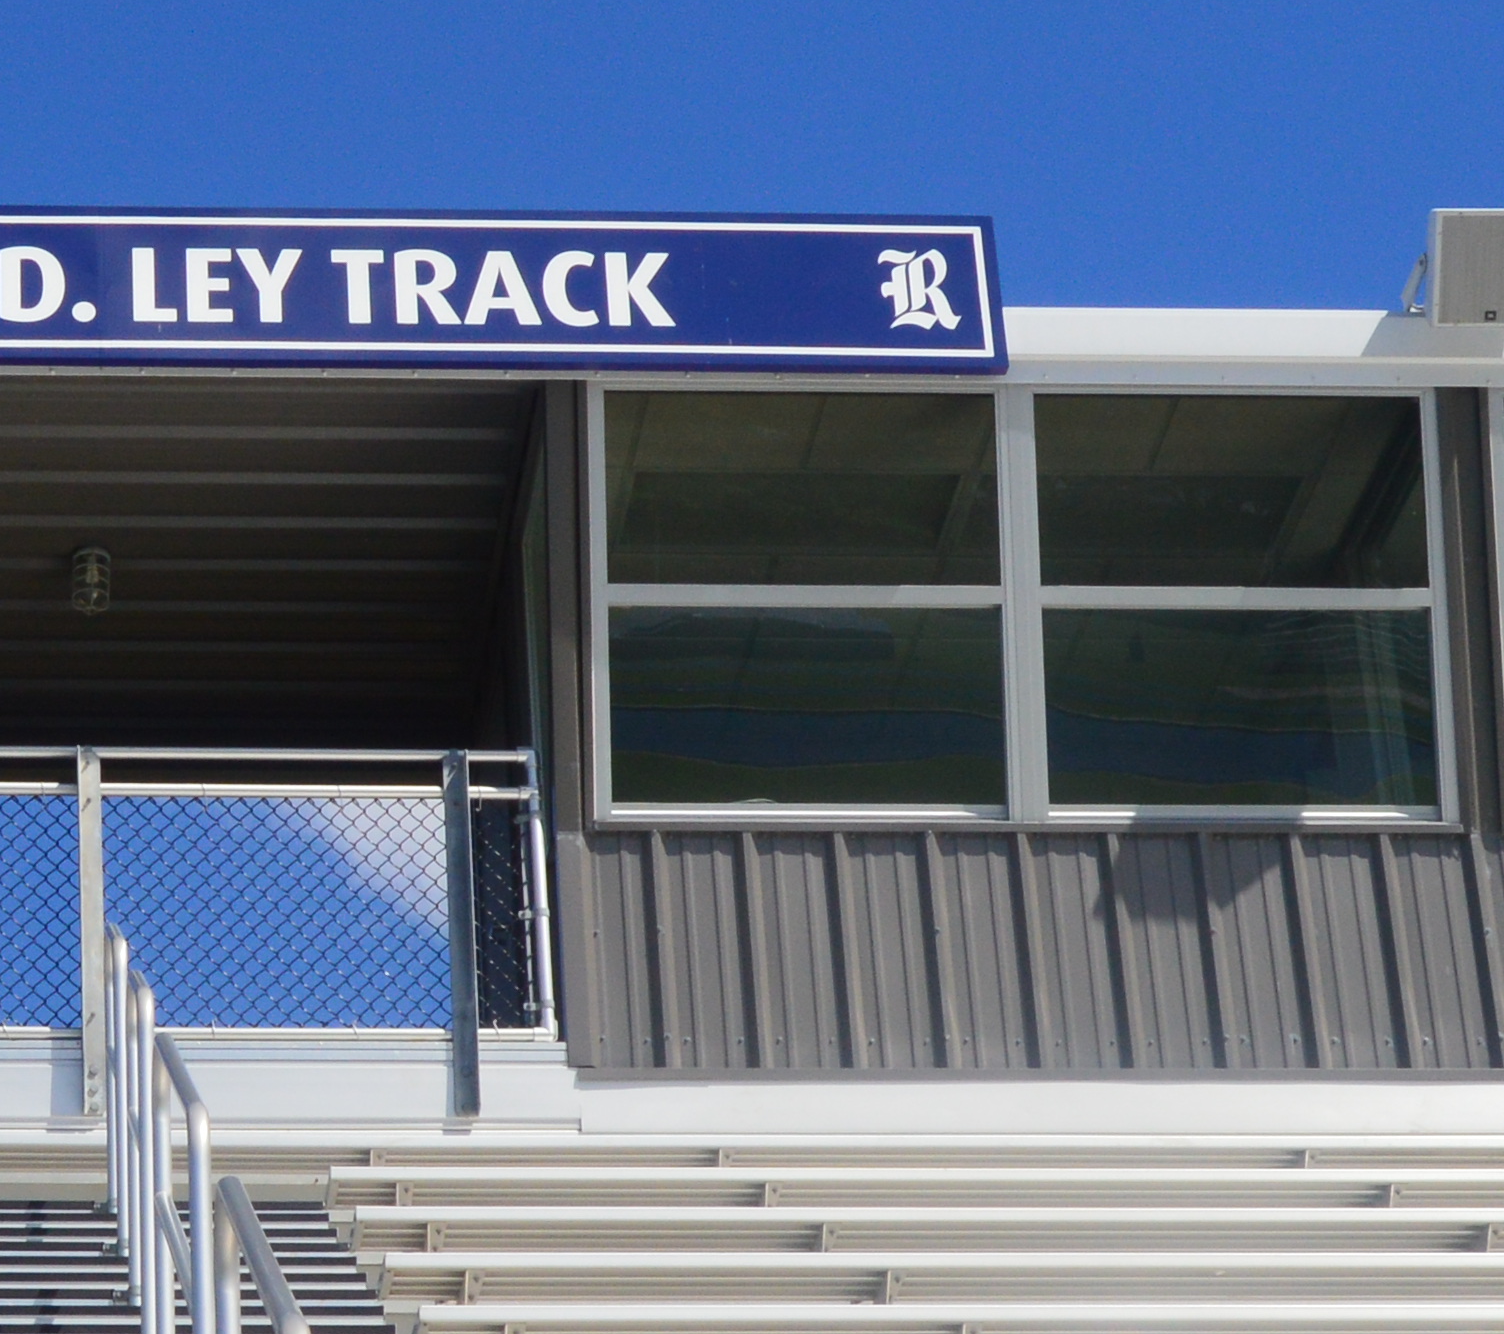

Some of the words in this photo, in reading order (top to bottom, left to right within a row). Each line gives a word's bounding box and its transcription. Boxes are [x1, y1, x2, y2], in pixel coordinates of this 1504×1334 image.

[131, 247, 304, 324] LEY
[329, 248, 677, 328] TRACK
[876, 248, 962, 331] R
